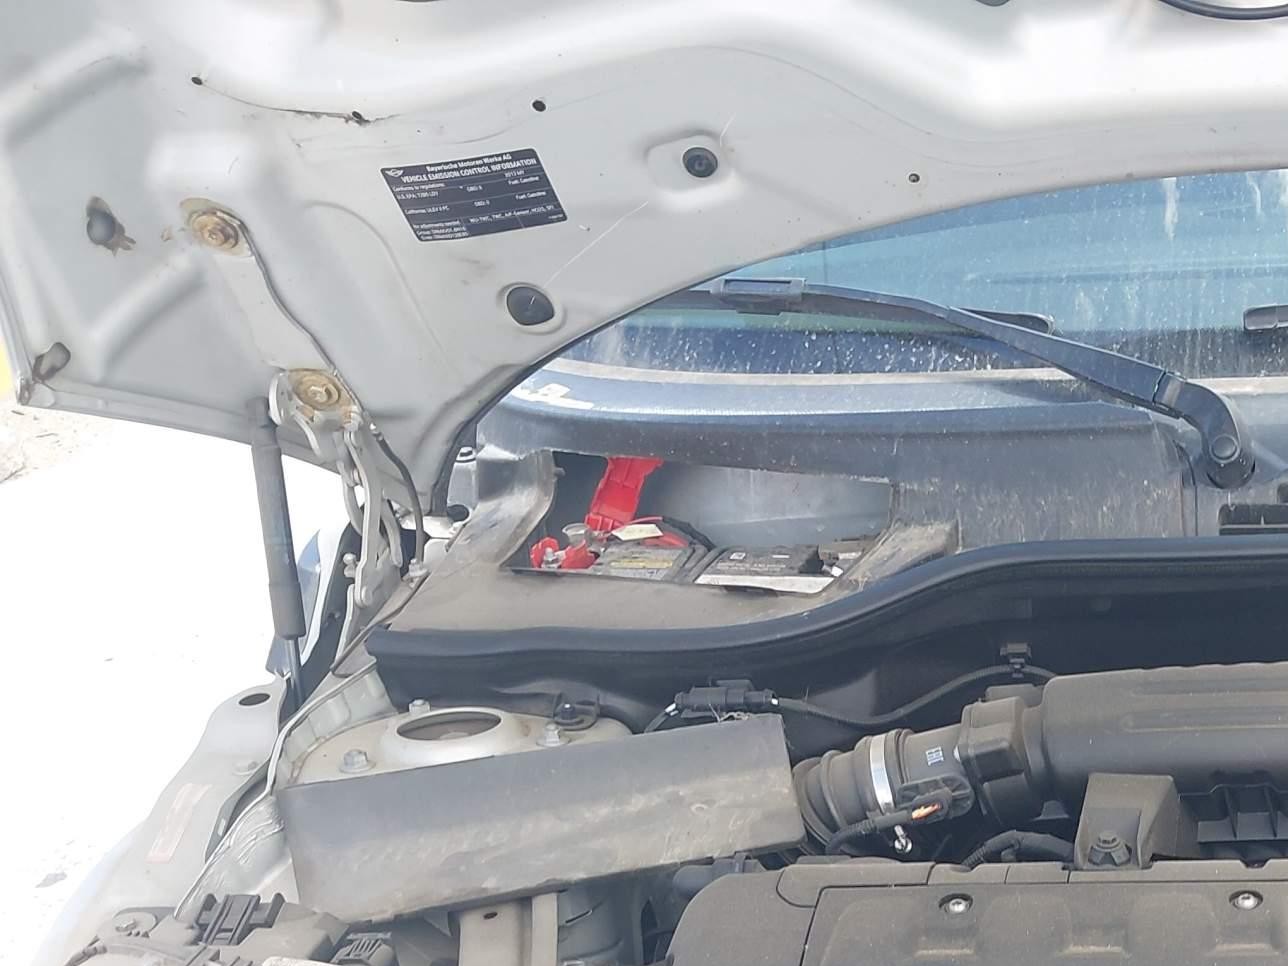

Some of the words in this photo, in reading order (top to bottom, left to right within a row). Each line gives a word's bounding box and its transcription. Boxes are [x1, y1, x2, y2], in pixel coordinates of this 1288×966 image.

[502, 153, 512, 161] AG
[400, 173, 428, 184] VEHICLE
[427, 170, 460, 181] EMISSION
[460, 165, 491, 177] CONTROL
[490, 158, 537, 172] INFORMATION
